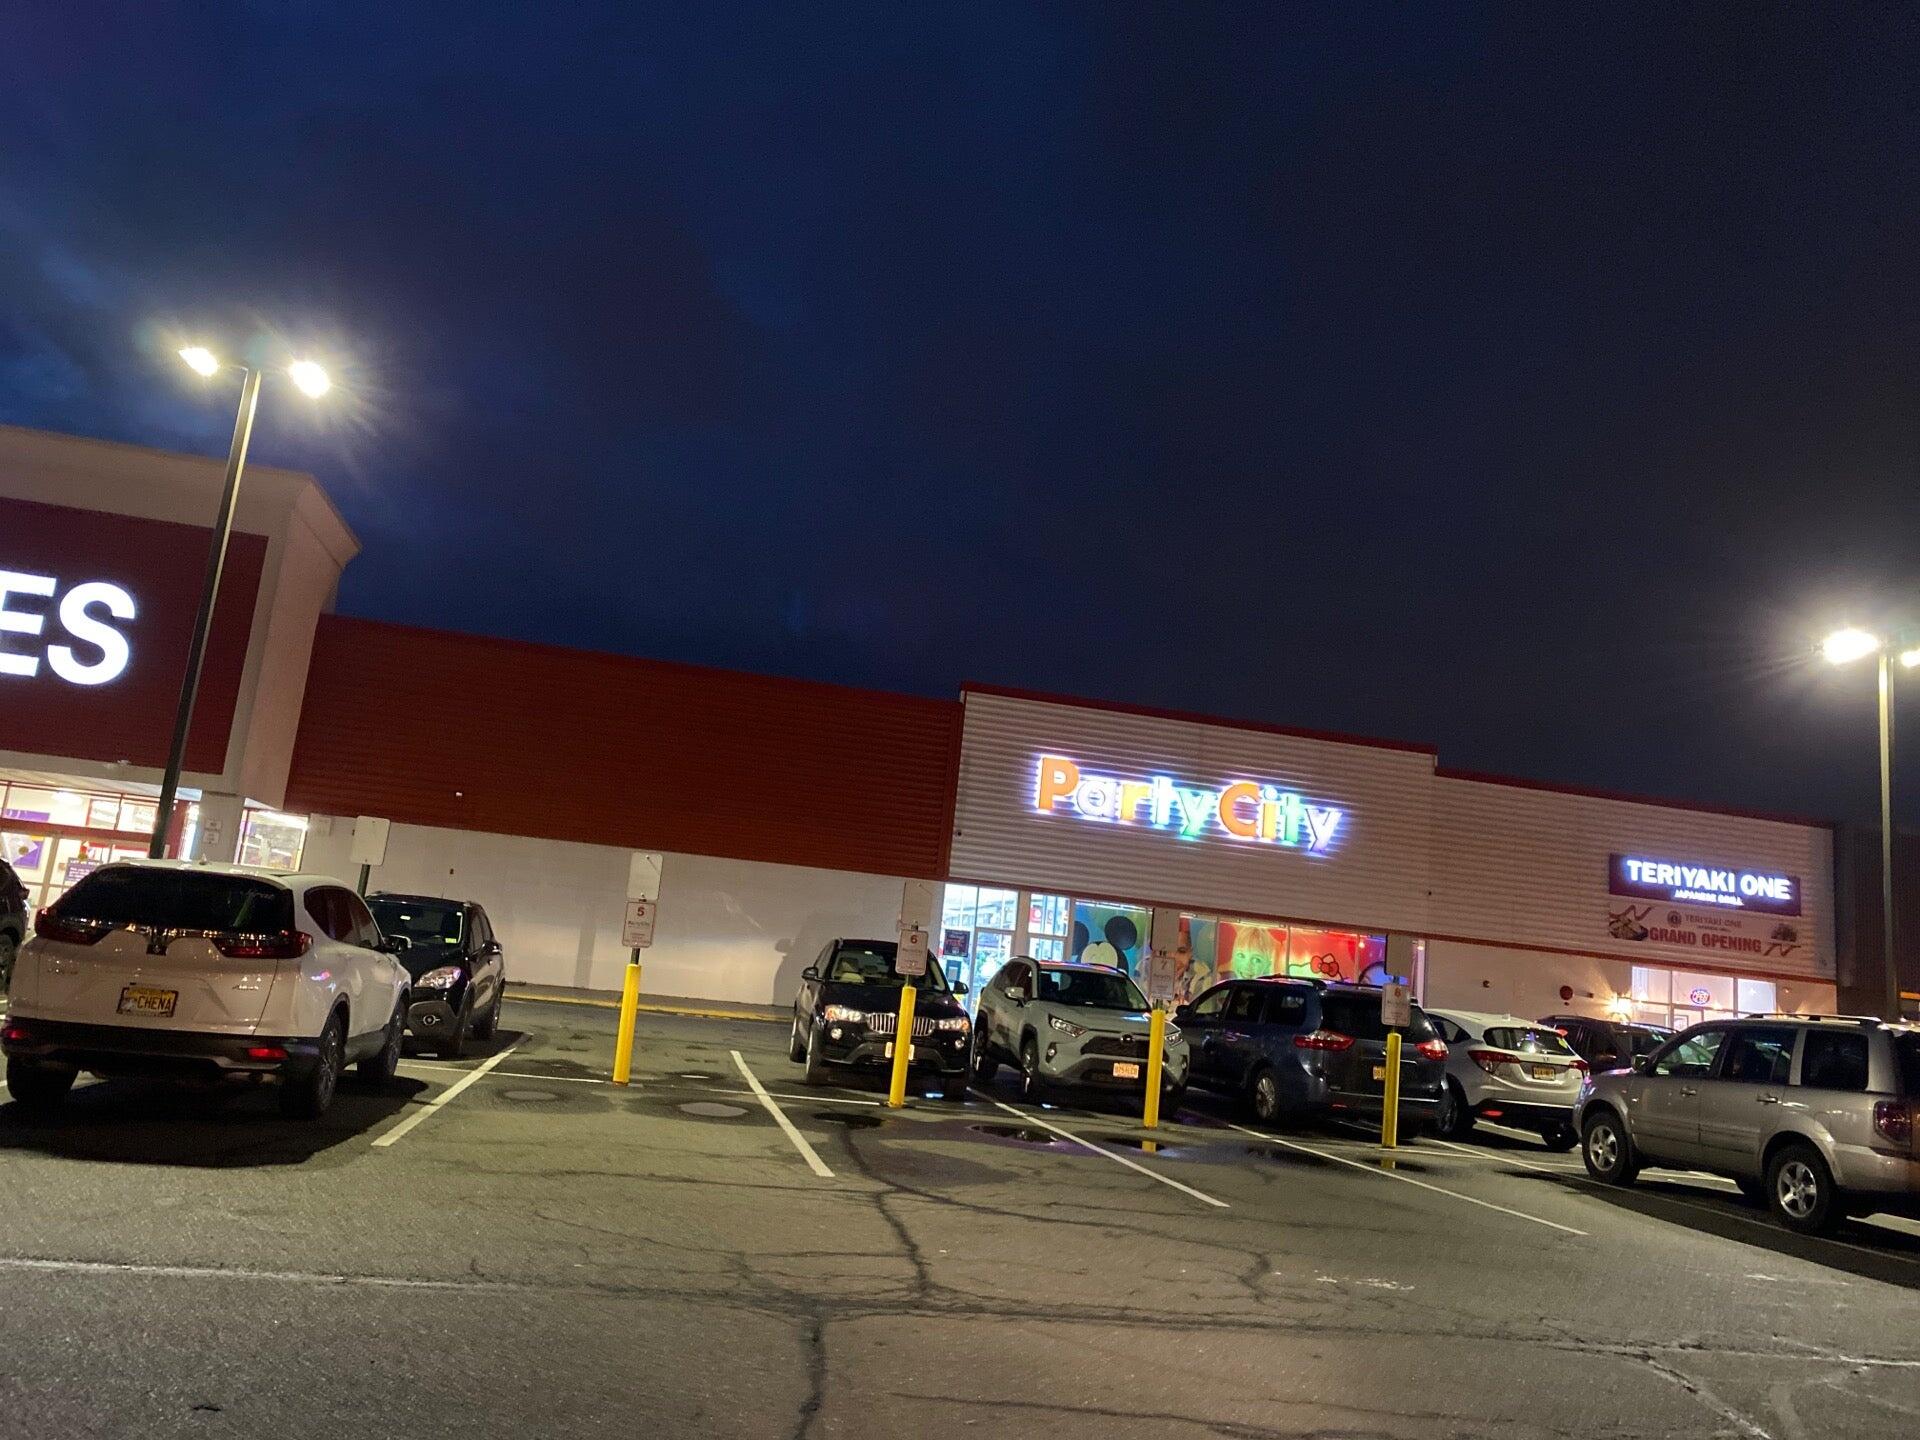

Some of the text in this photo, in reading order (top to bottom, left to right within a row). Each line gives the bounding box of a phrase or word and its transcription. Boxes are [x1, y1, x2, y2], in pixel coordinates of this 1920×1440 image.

[0, 569, 136, 686] ES
[1037, 756, 1342, 852] Party City
[1626, 859, 1793, 900] TERIYAKI ONE
[637, 906, 645, 917] 5
[1650, 926, 1762, 952] GRAND OPENING
